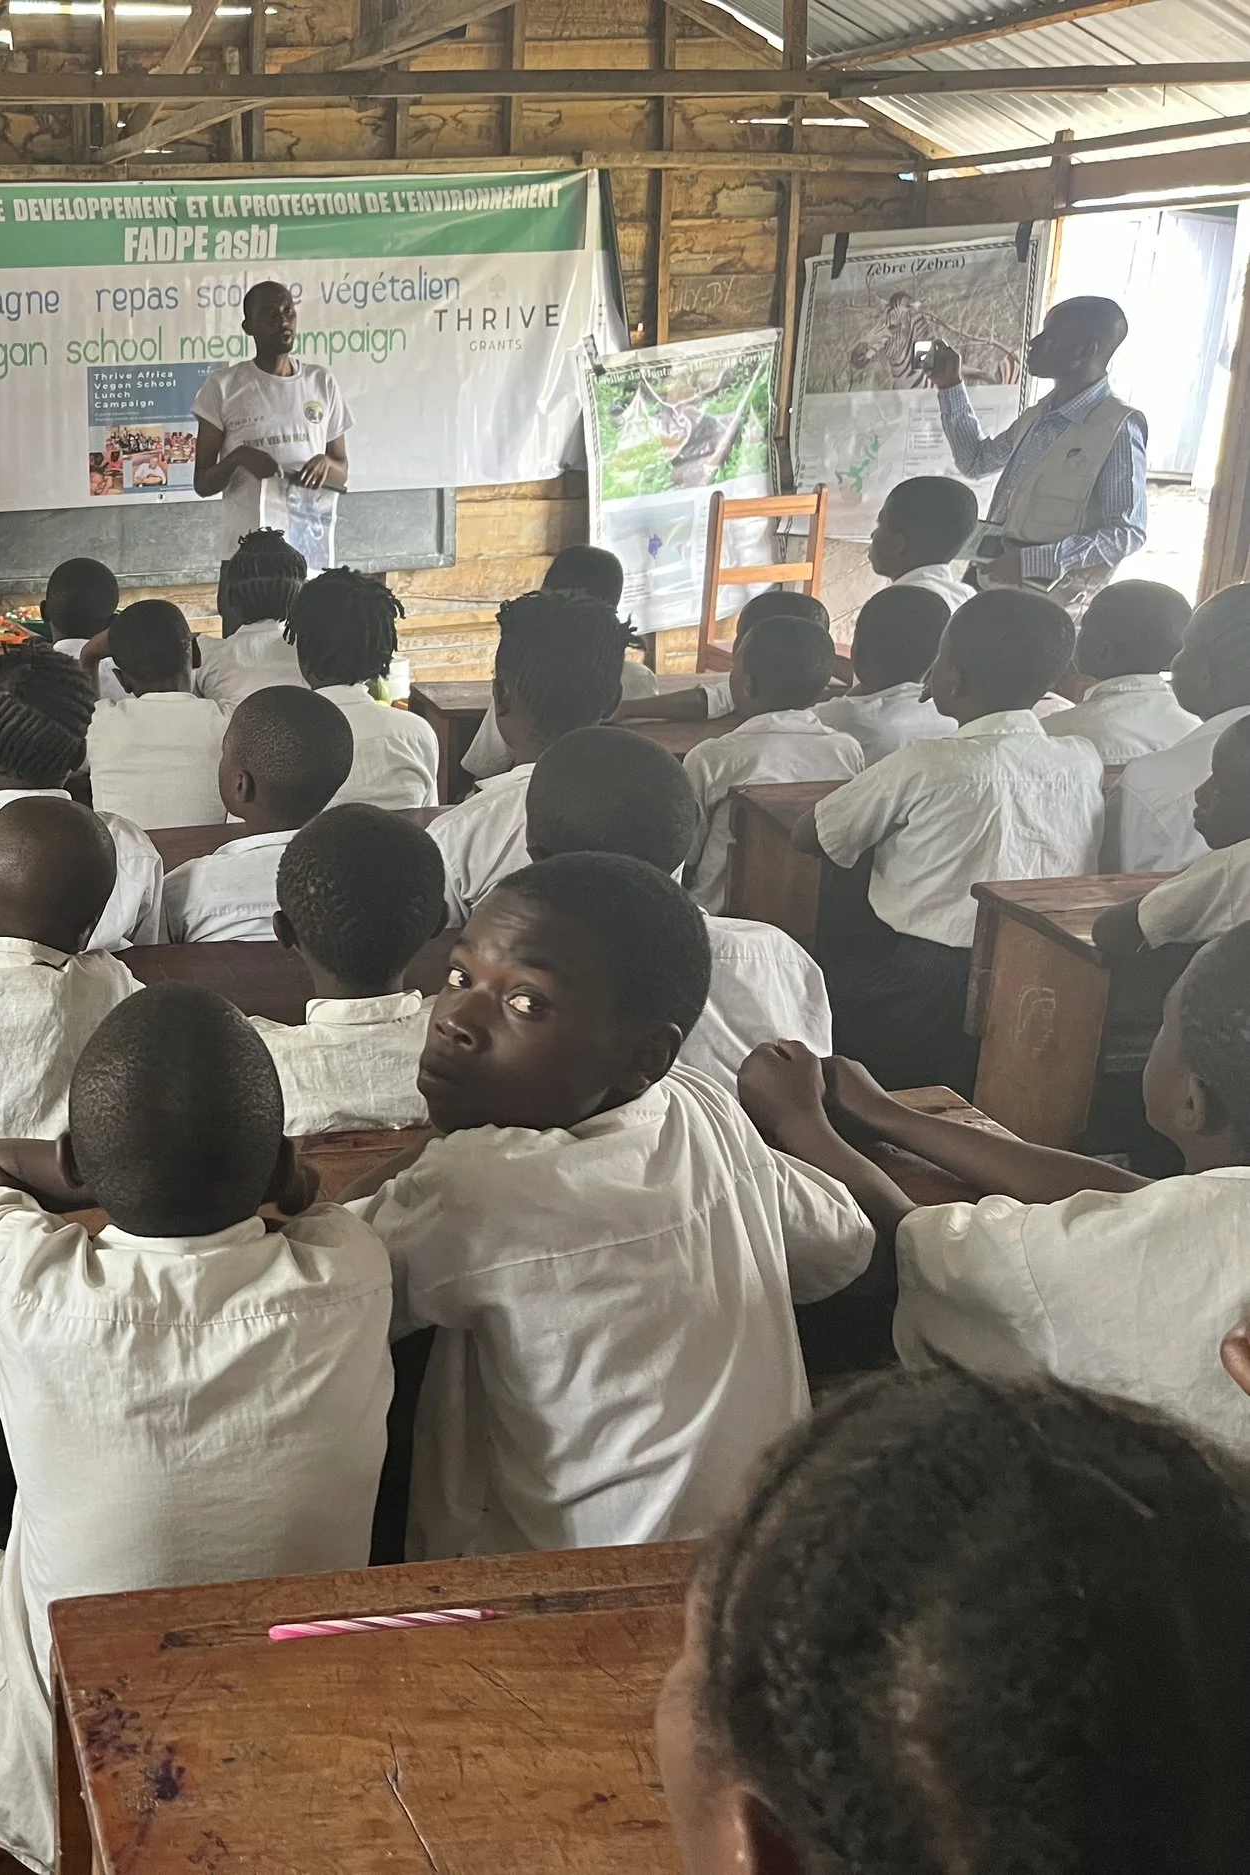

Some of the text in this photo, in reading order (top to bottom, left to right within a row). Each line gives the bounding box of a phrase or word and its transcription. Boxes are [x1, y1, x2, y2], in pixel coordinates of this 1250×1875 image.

[13, 195, 178, 223] DEVELOPPEMENT
[186, 195, 208, 218] ET
[213, 195, 237, 218] LA
[240, 191, 362, 218] PROTECTION
[366, 189, 391, 214] DE
[393, 183, 563, 213] L'ENVIRONNEMENT
[124, 223, 279, 263] FADPE asbl
[866, 256, 966, 277] Zèbre (Zebra)
[95, 284, 179, 318] repas
[196, 270, 303, 309] scole
[321, 265, 460, 310] végétalien
[434, 303, 559, 332] THRIVE
[66, 325, 163, 365] school
[469, 338, 522, 352] GRANTS
[93, 370, 173, 381] Thrive Africa
[93, 379, 176, 391] Vegan School
[94, 391, 131, 400] Lunch
[94, 399, 154, 409] Campaign
